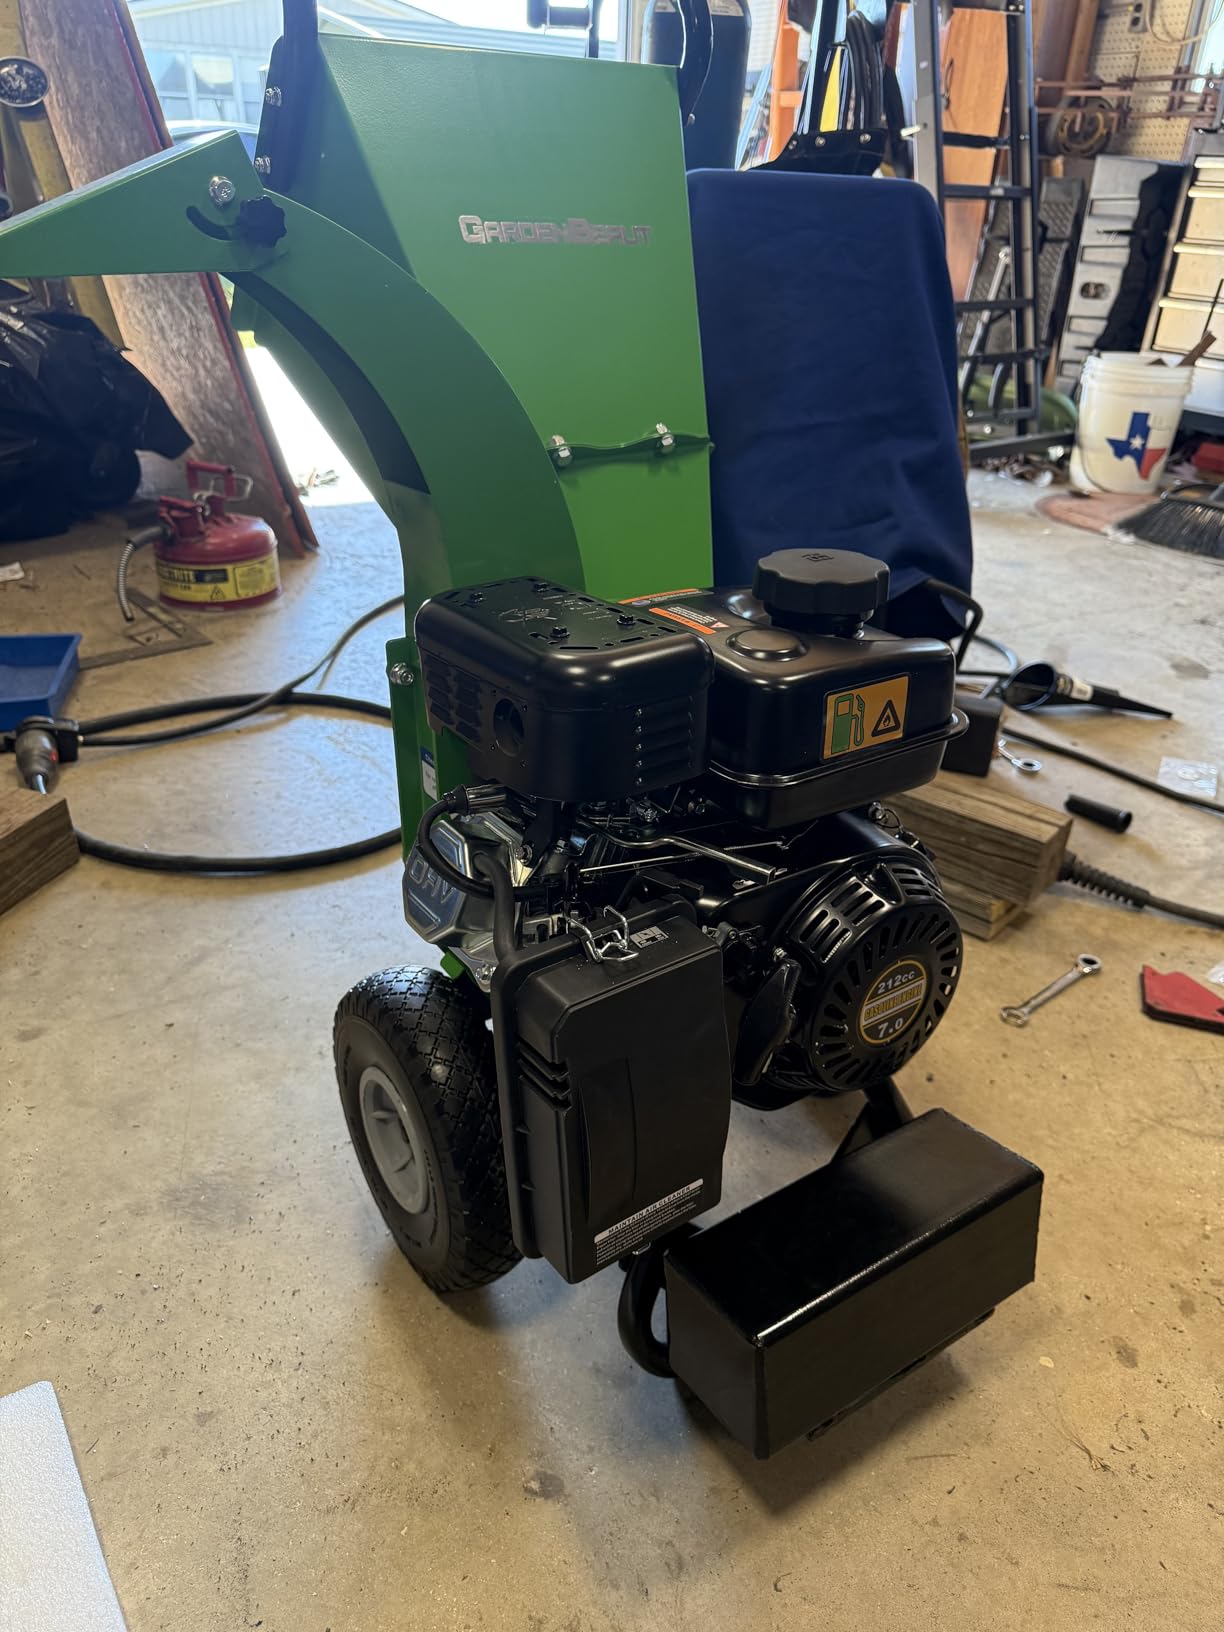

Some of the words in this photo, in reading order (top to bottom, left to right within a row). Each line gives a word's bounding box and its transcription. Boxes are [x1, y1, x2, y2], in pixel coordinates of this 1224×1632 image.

[878, 970, 916, 993] 212cc
[878, 1017, 903, 1038] 7.0
[608, 1211, 644, 1235] MAINTAIN
[645, 1205, 658, 1216] AIR
[658, 1186, 691, 1207] CLEANER
